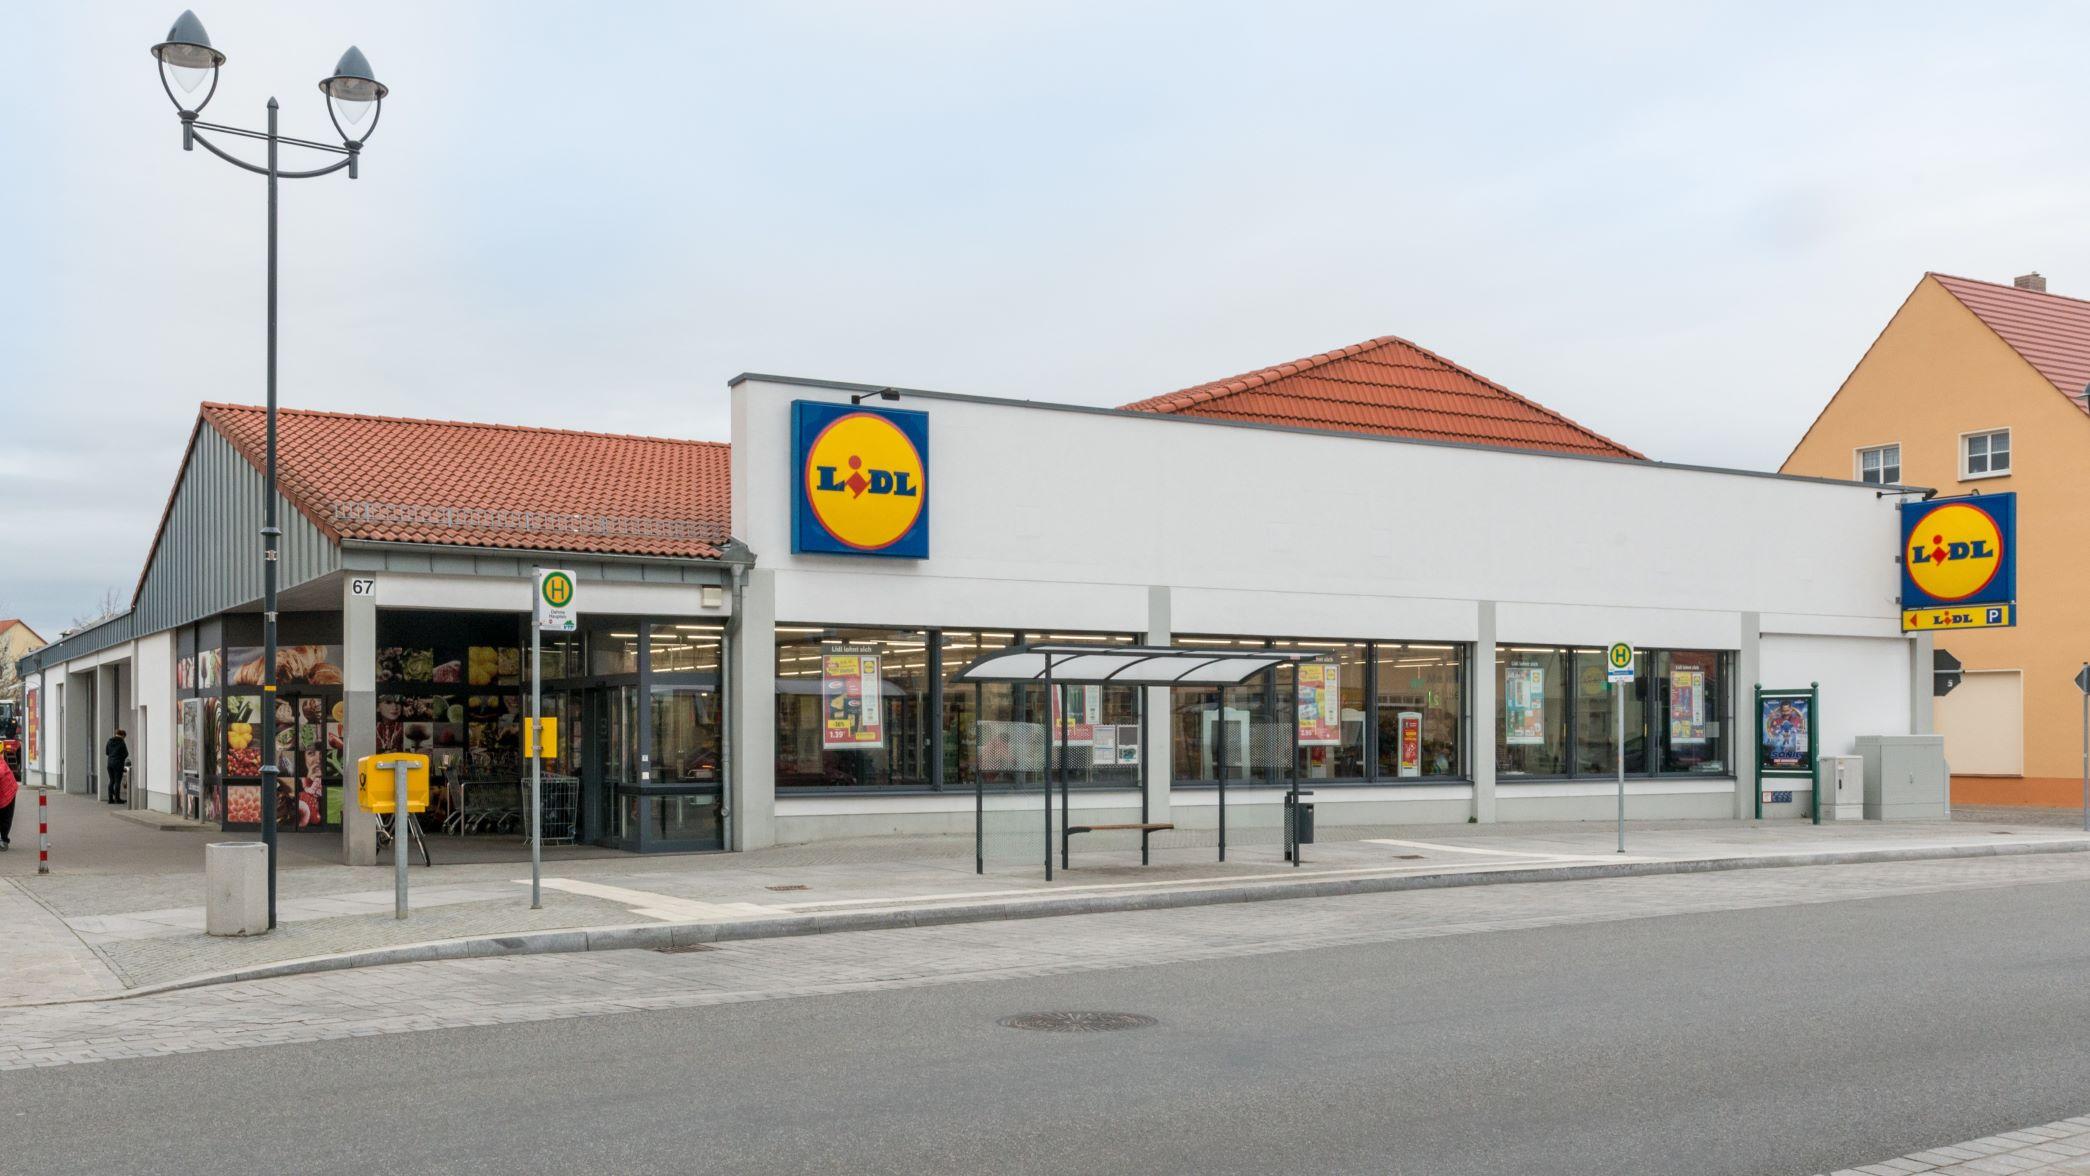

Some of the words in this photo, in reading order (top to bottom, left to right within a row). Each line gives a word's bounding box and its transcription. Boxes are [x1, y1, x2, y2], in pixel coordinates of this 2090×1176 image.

[816, 455, 917, 499] LIDL
[1912, 534, 1994, 566] LIDL
[353, 579, 374, 595] 67
[552, 580, 564, 600] H
[1932, 610, 1974, 626] LIDL
[1988, 609, 2000, 623] P
[831, 645, 843, 653] Lidl
[843, 645, 859, 653] lohnt
[1615, 648, 1626, 662] H
